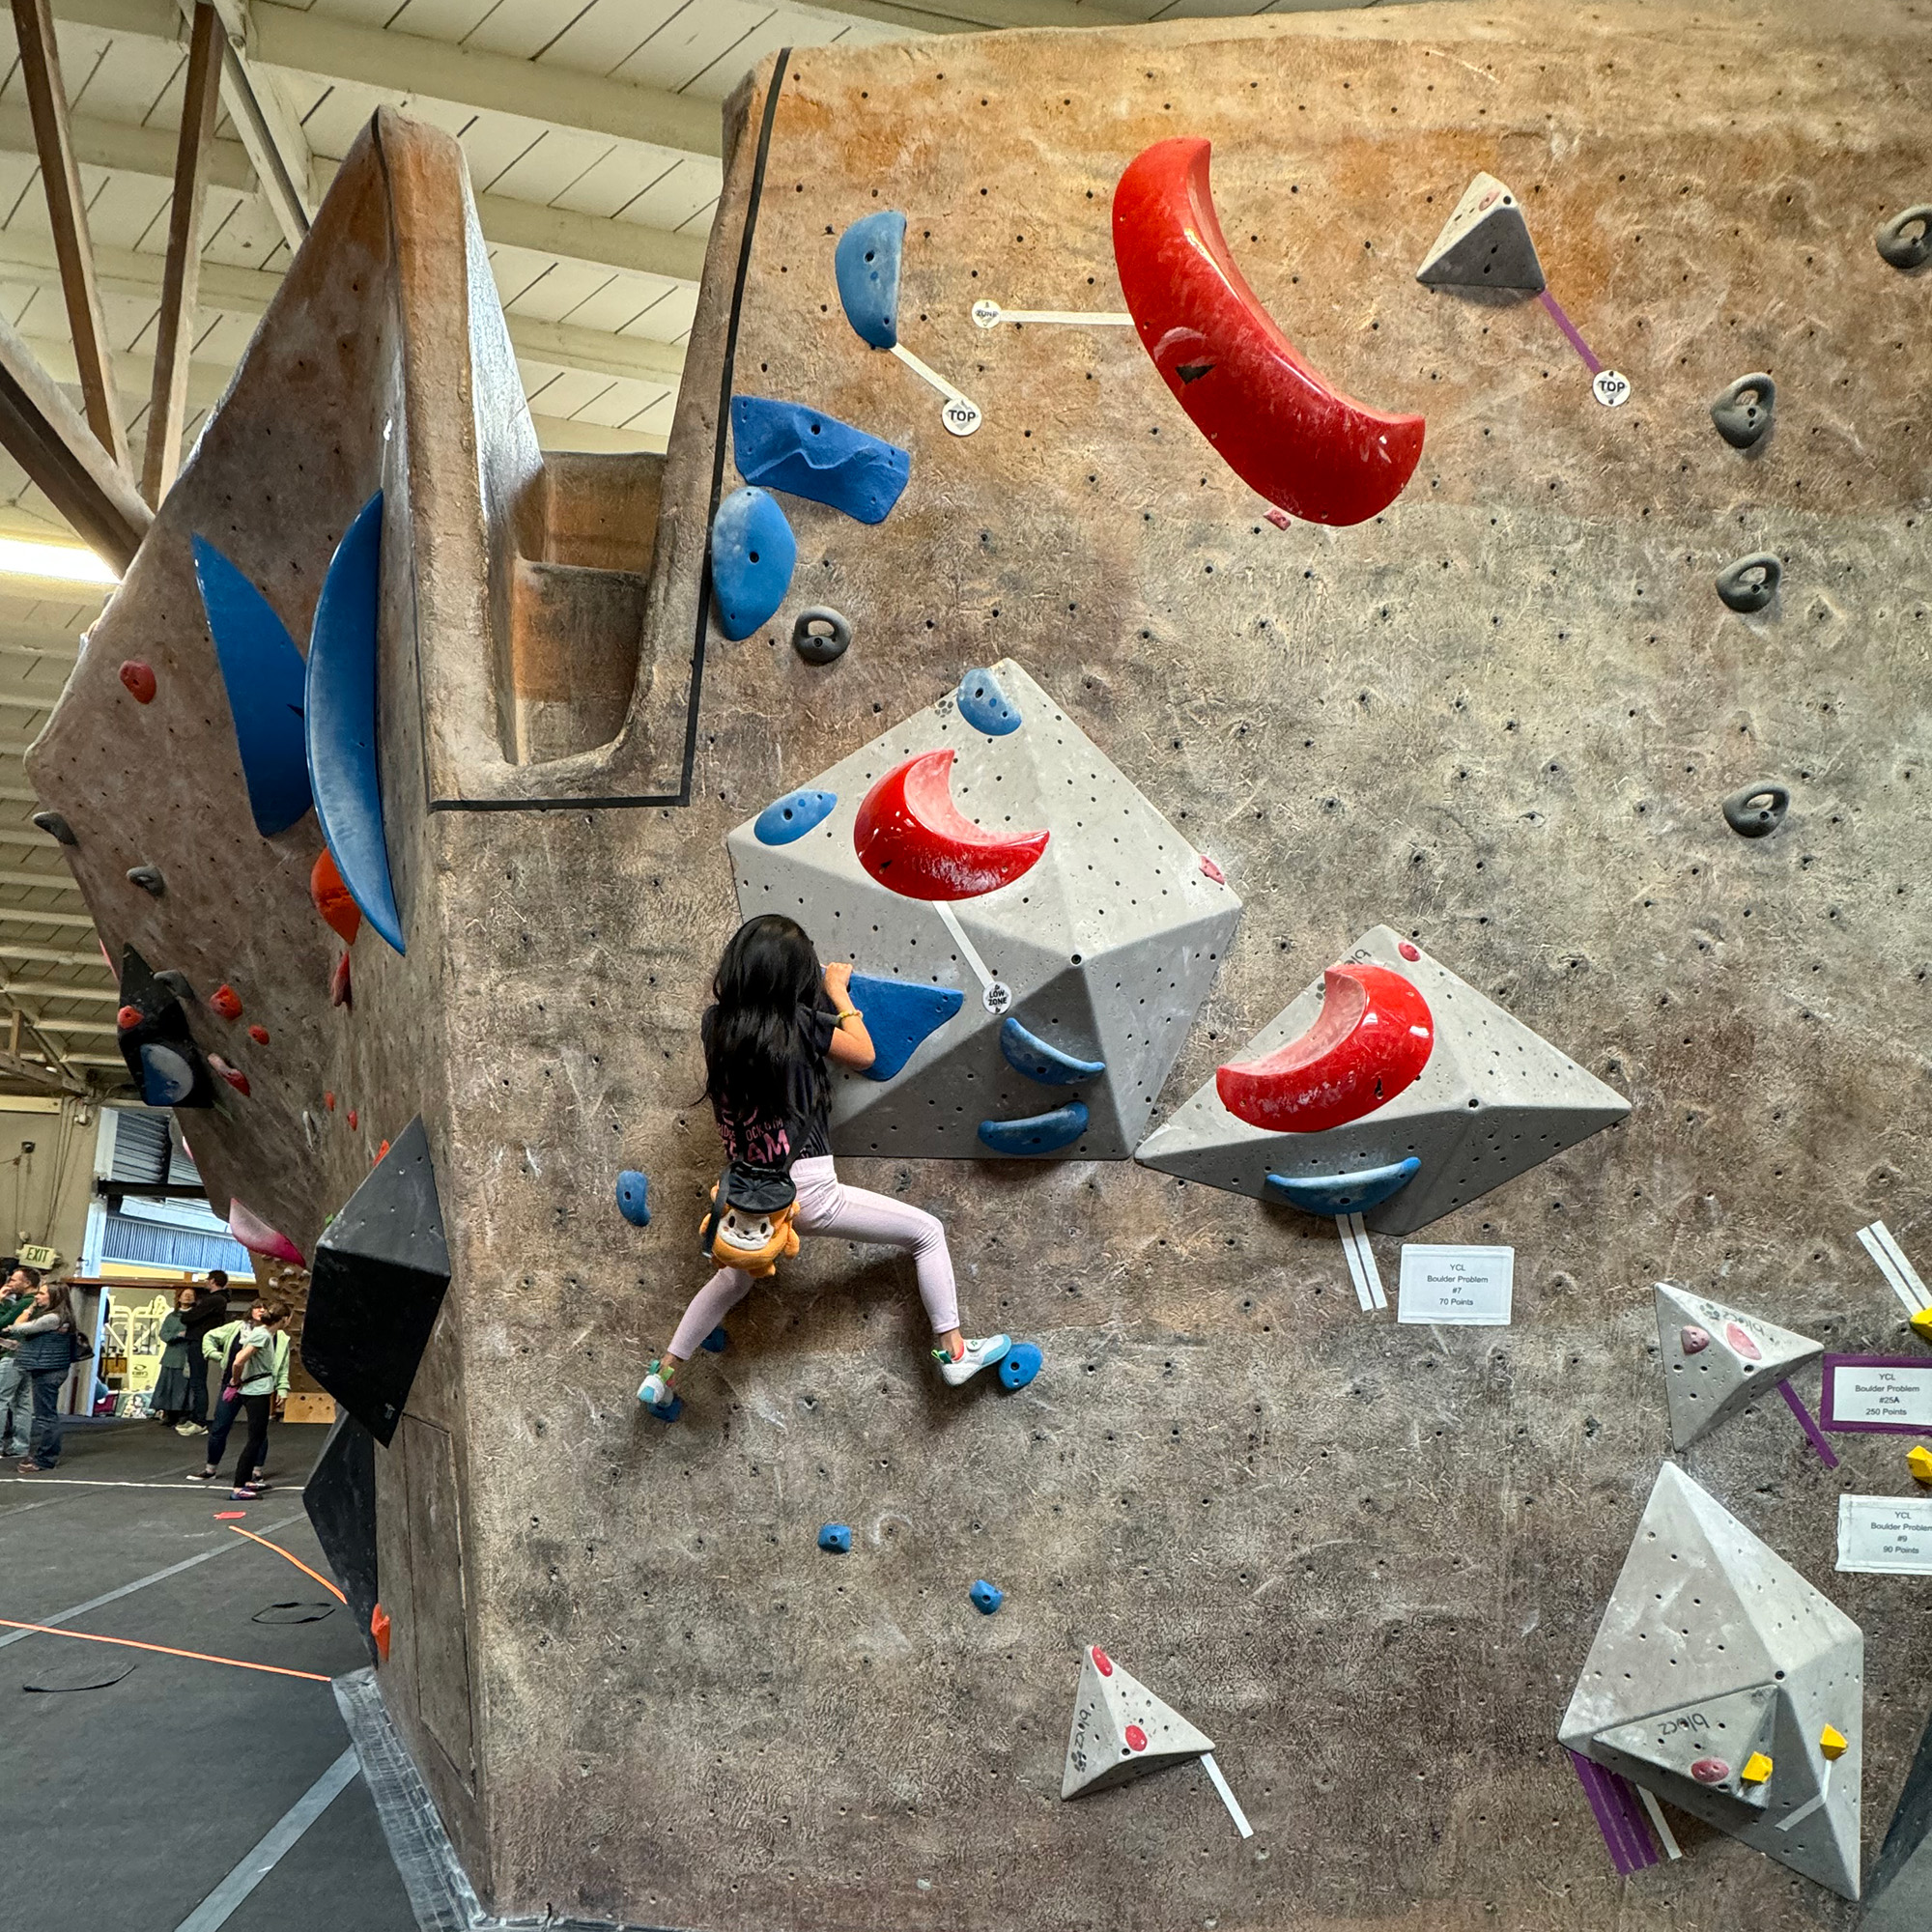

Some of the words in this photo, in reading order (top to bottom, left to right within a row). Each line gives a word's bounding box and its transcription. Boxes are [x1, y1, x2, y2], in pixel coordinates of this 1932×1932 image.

[1599, 380, 1626, 393] TOP
[949, 410, 977, 422] TOP
[988, 989, 1005, 999] LOW
[988, 997, 1008, 1007] ZONE
[24, 1247, 50, 1264] EXIT
[1894, 1511, 1912, 1520] YCL
